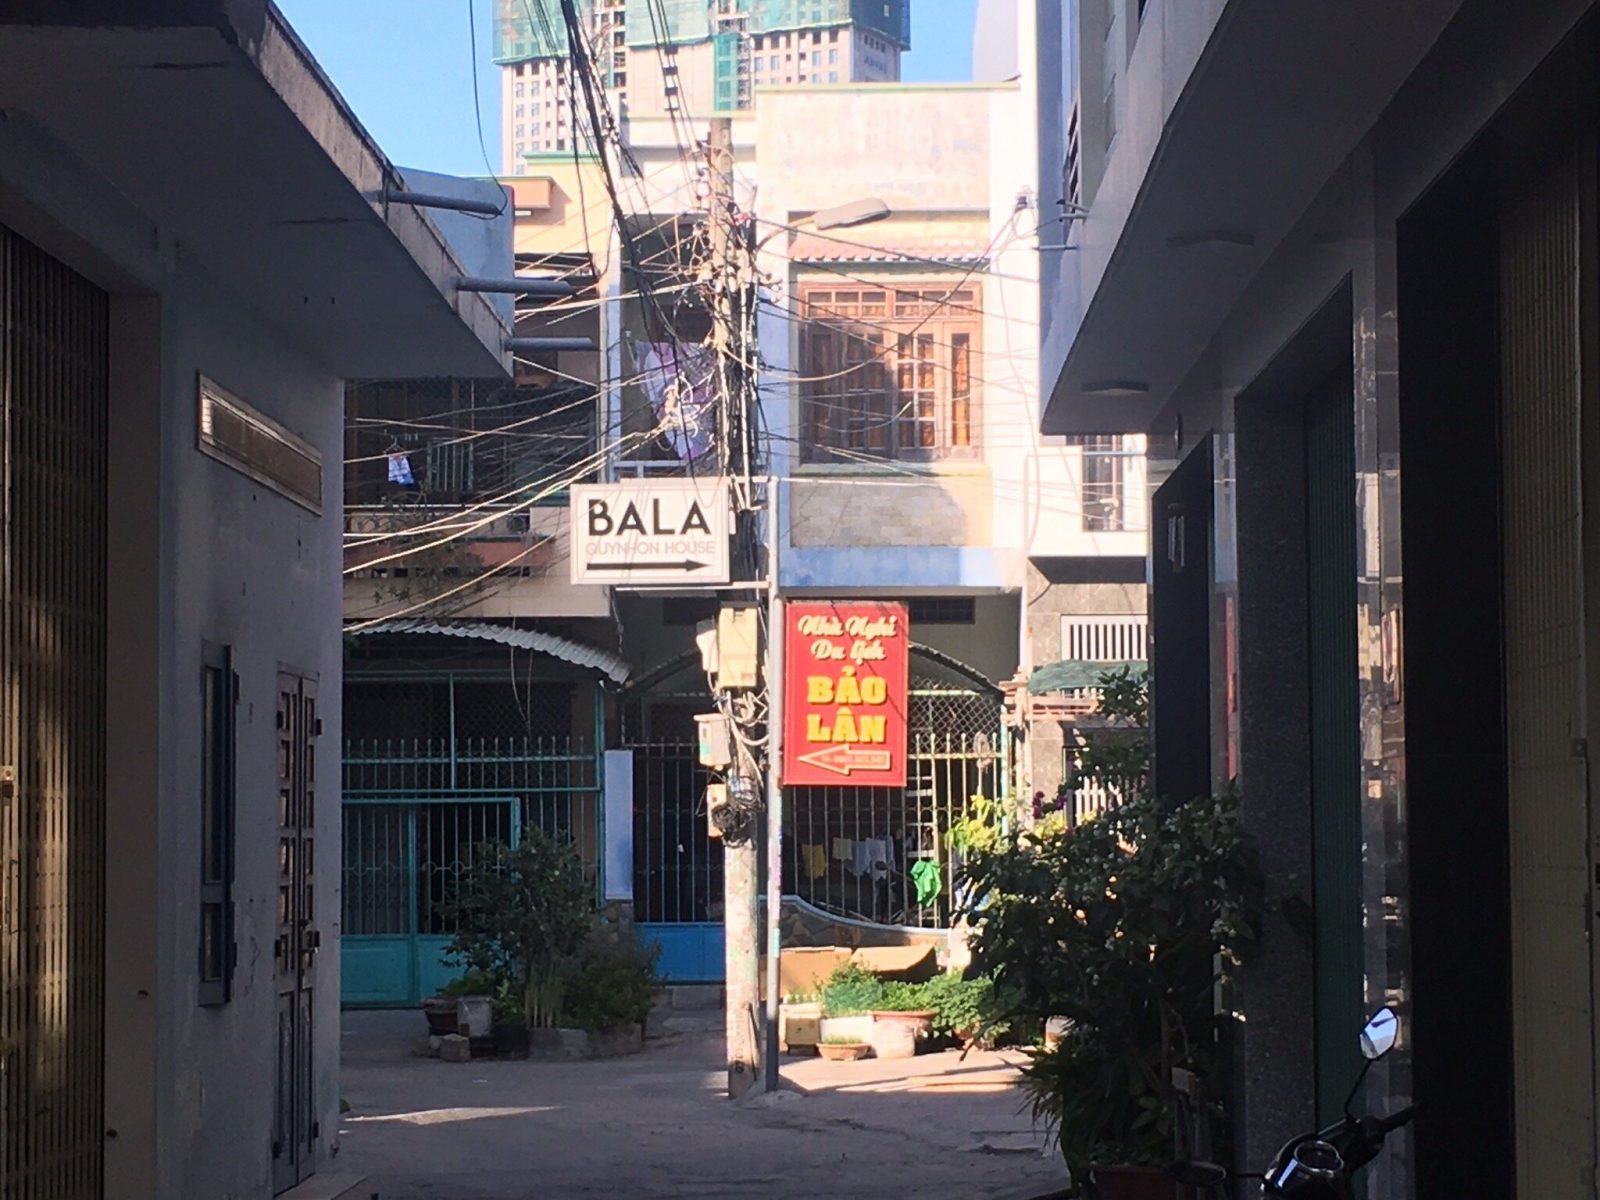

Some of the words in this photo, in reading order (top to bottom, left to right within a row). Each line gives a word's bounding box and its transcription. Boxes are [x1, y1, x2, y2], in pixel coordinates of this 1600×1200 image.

[588, 498, 711, 536] BALA
[585, 541, 660, 556] QUYNHON
[664, 540, 717, 554] HOUSE
[810, 638, 846, 660] Du
[807, 665, 887, 704] BẢO
[806, 706, 886, 743] LÂN
